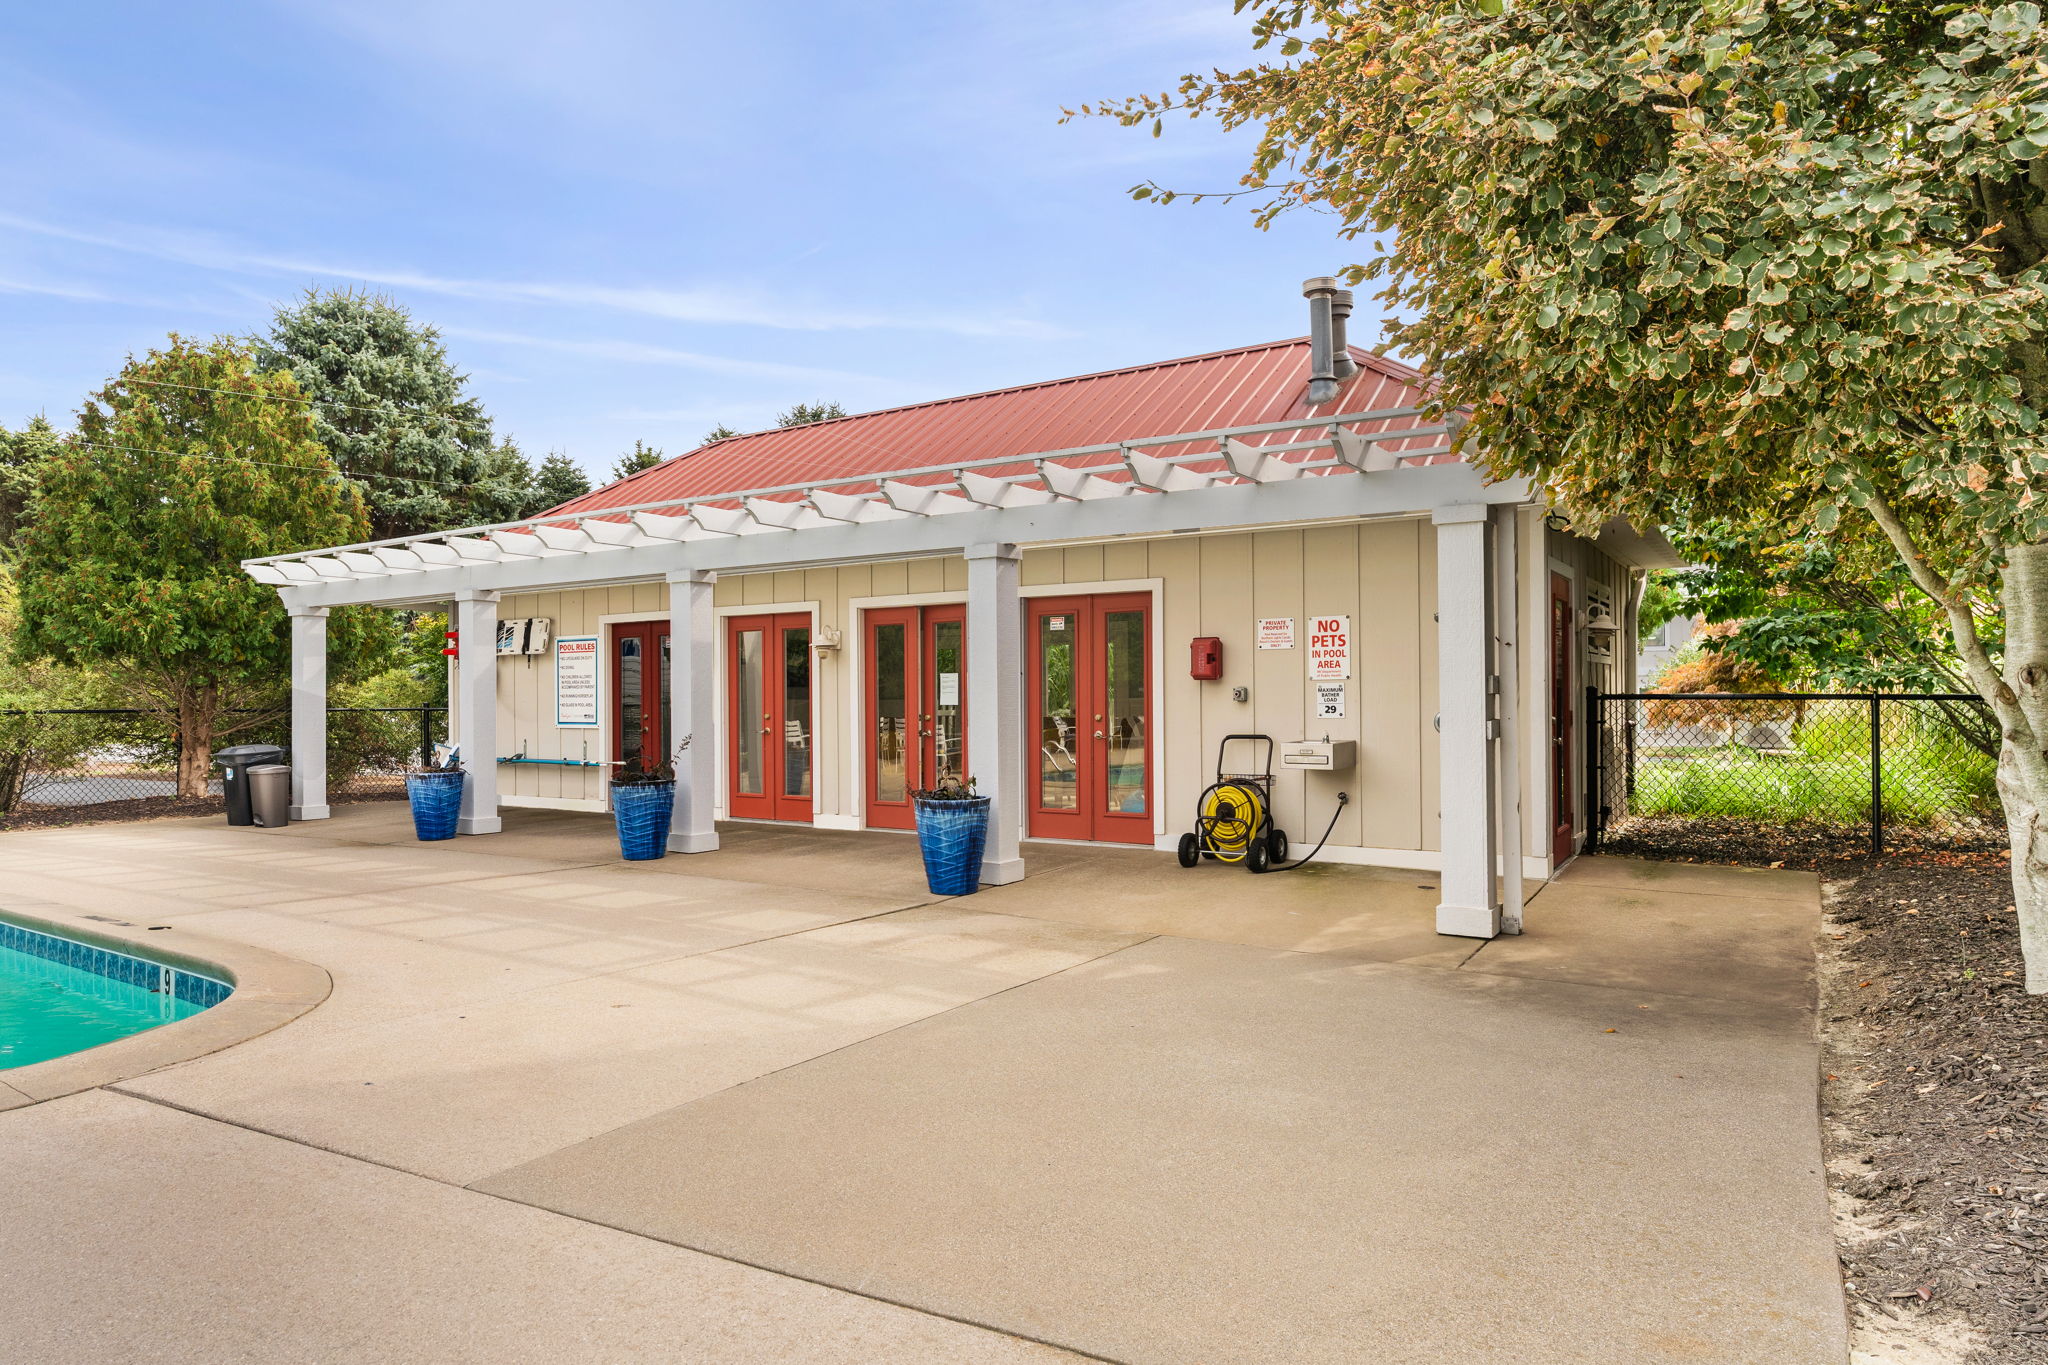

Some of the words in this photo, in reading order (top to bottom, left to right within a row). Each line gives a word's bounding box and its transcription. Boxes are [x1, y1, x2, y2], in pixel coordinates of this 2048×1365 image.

[1318, 619, 1340, 632] NO
[1311, 634, 1346, 648] PETS
[1312, 650, 1321, 658] IN
[1323, 649, 1347, 658] POOL
[1317, 660, 1341, 669] AREA
[1324, 705, 1337, 714] 29
[164, 969, 171, 996] 9
